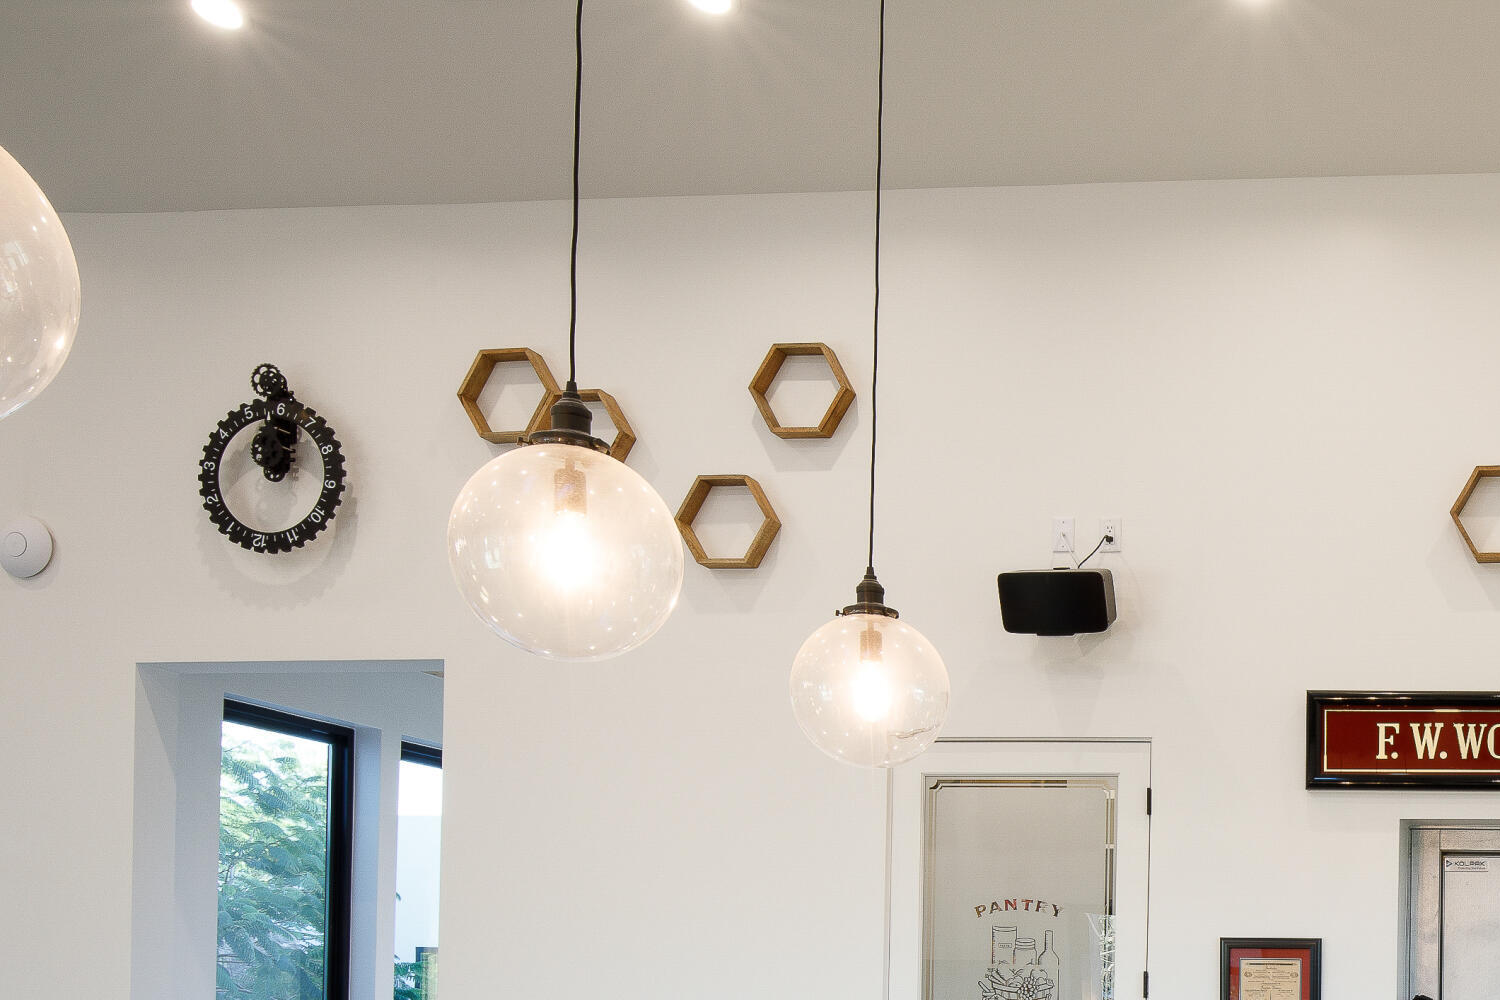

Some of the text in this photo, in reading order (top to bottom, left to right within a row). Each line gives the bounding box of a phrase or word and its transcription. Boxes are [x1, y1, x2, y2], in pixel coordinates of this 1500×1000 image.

[244, 406, 254, 419] 5
[276, 402, 285, 415] 6
[304, 417, 316, 428] 7
[219, 427, 229, 439] 4
[321, 444, 333, 454] 8
[203, 460, 216, 471] 3
[324, 479, 336, 489] 9
[206, 494, 218, 504] 2
[309, 508, 326, 523] 10
[226, 521, 236, 530] 1
[252, 533, 266, 547] 12
[286, 531, 300, 543] 11
[1376, 723, 1399, 760] F.
[1410, 723, 1447, 760] W.
